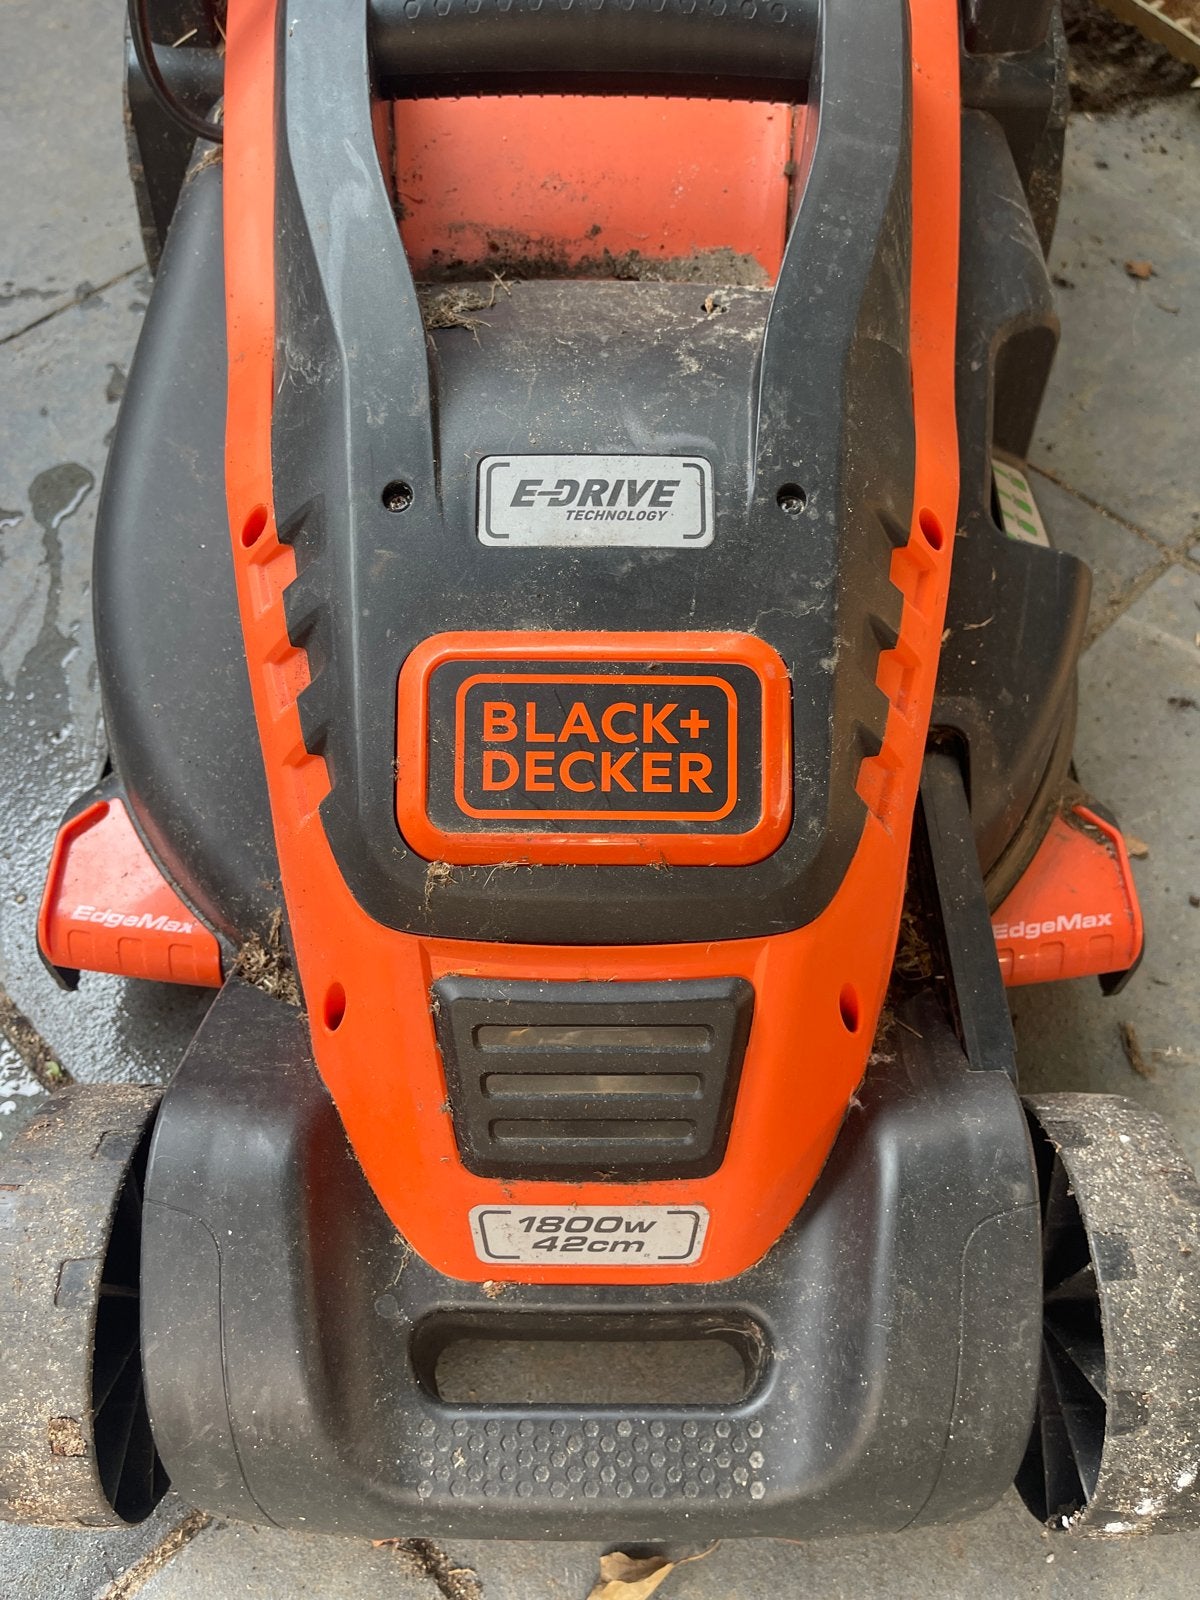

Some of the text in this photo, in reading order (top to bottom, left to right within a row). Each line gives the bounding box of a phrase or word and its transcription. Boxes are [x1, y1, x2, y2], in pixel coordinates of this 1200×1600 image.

[510, 479, 681, 507] E-DRIVE
[566, 510, 668, 521] TECHNOLOGY
[483, 702, 710, 744] BLACK+
[482, 751, 714, 793] DECKER
[70, 905, 194, 934] EdgeMax
[992, 913, 1112, 940] EdgeMax
[532, 1236, 645, 1252] 42cm
